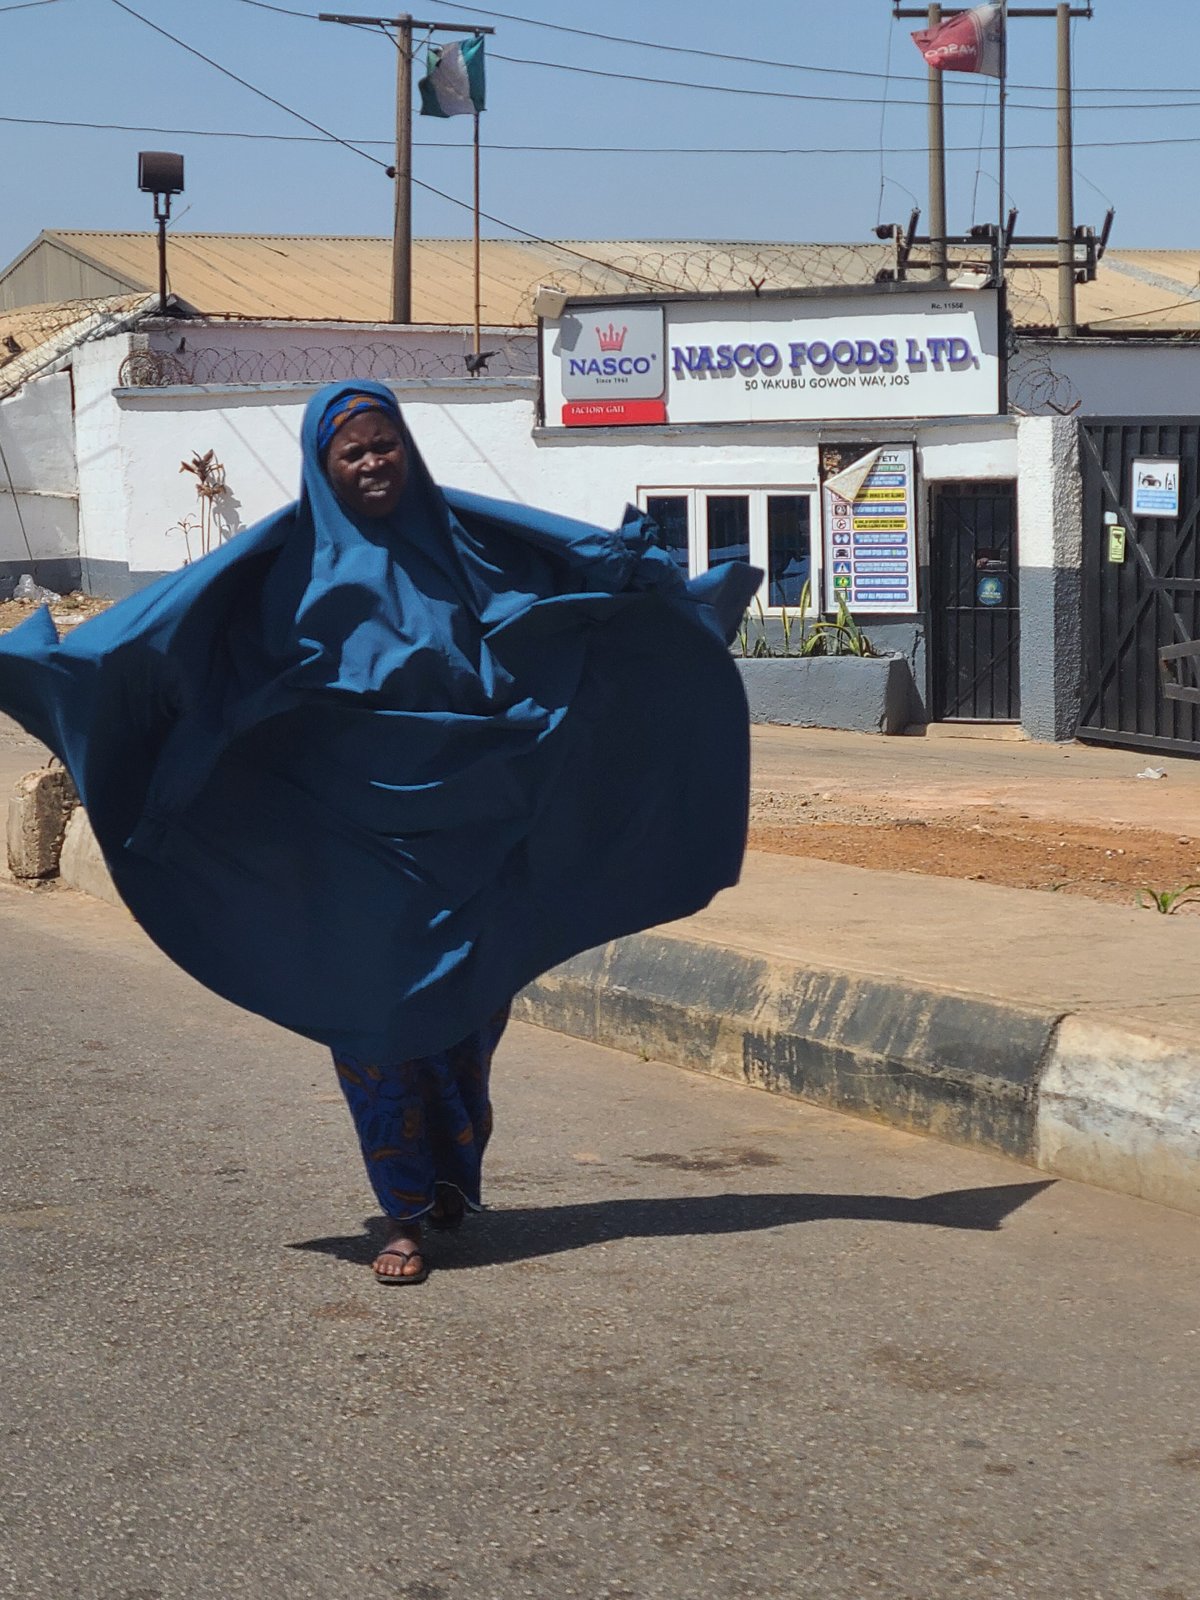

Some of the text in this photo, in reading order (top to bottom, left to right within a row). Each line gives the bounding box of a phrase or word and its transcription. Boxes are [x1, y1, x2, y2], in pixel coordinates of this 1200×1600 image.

[672, 343, 779, 371] NASCO
[788, 338, 896, 368] FOODS
[570, 357, 651, 376] NASCO
[744, 375, 910, 391] 50 YAKUBU GOWON WAY, JOS
[571, 406, 604, 414] FACTORY
